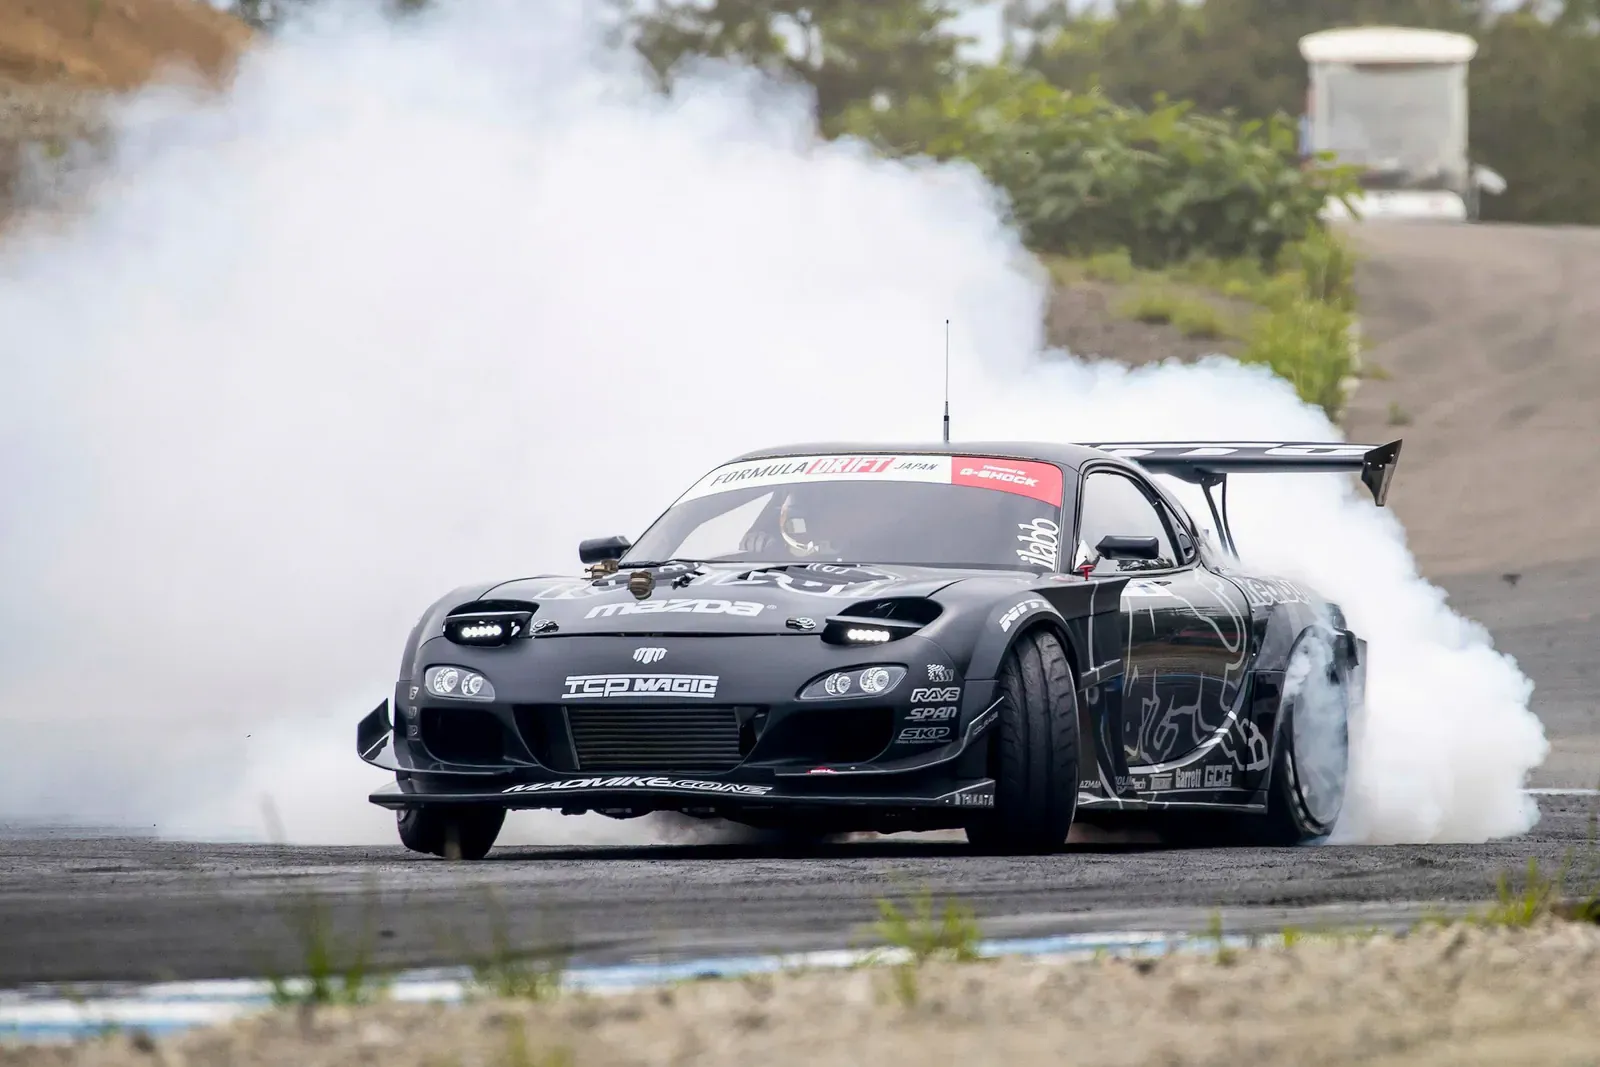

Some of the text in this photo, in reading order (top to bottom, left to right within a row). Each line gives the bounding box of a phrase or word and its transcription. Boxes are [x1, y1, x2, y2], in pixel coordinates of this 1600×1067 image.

[709, 457, 939, 487] FORMULA DRIFT JAPAN
[960, 467, 1039, 487] G-SHOCK
[1015, 517, 1059, 571] ilabb
[564, 678, 719, 698] TCP MAGIC
[910, 687, 961, 703] RAYS
[904, 706, 958, 720] SPAN
[1175, 767, 1202, 789] Garrett
[1203, 764, 1233, 788] GCG
[961, 793, 994, 806] TAKATA
